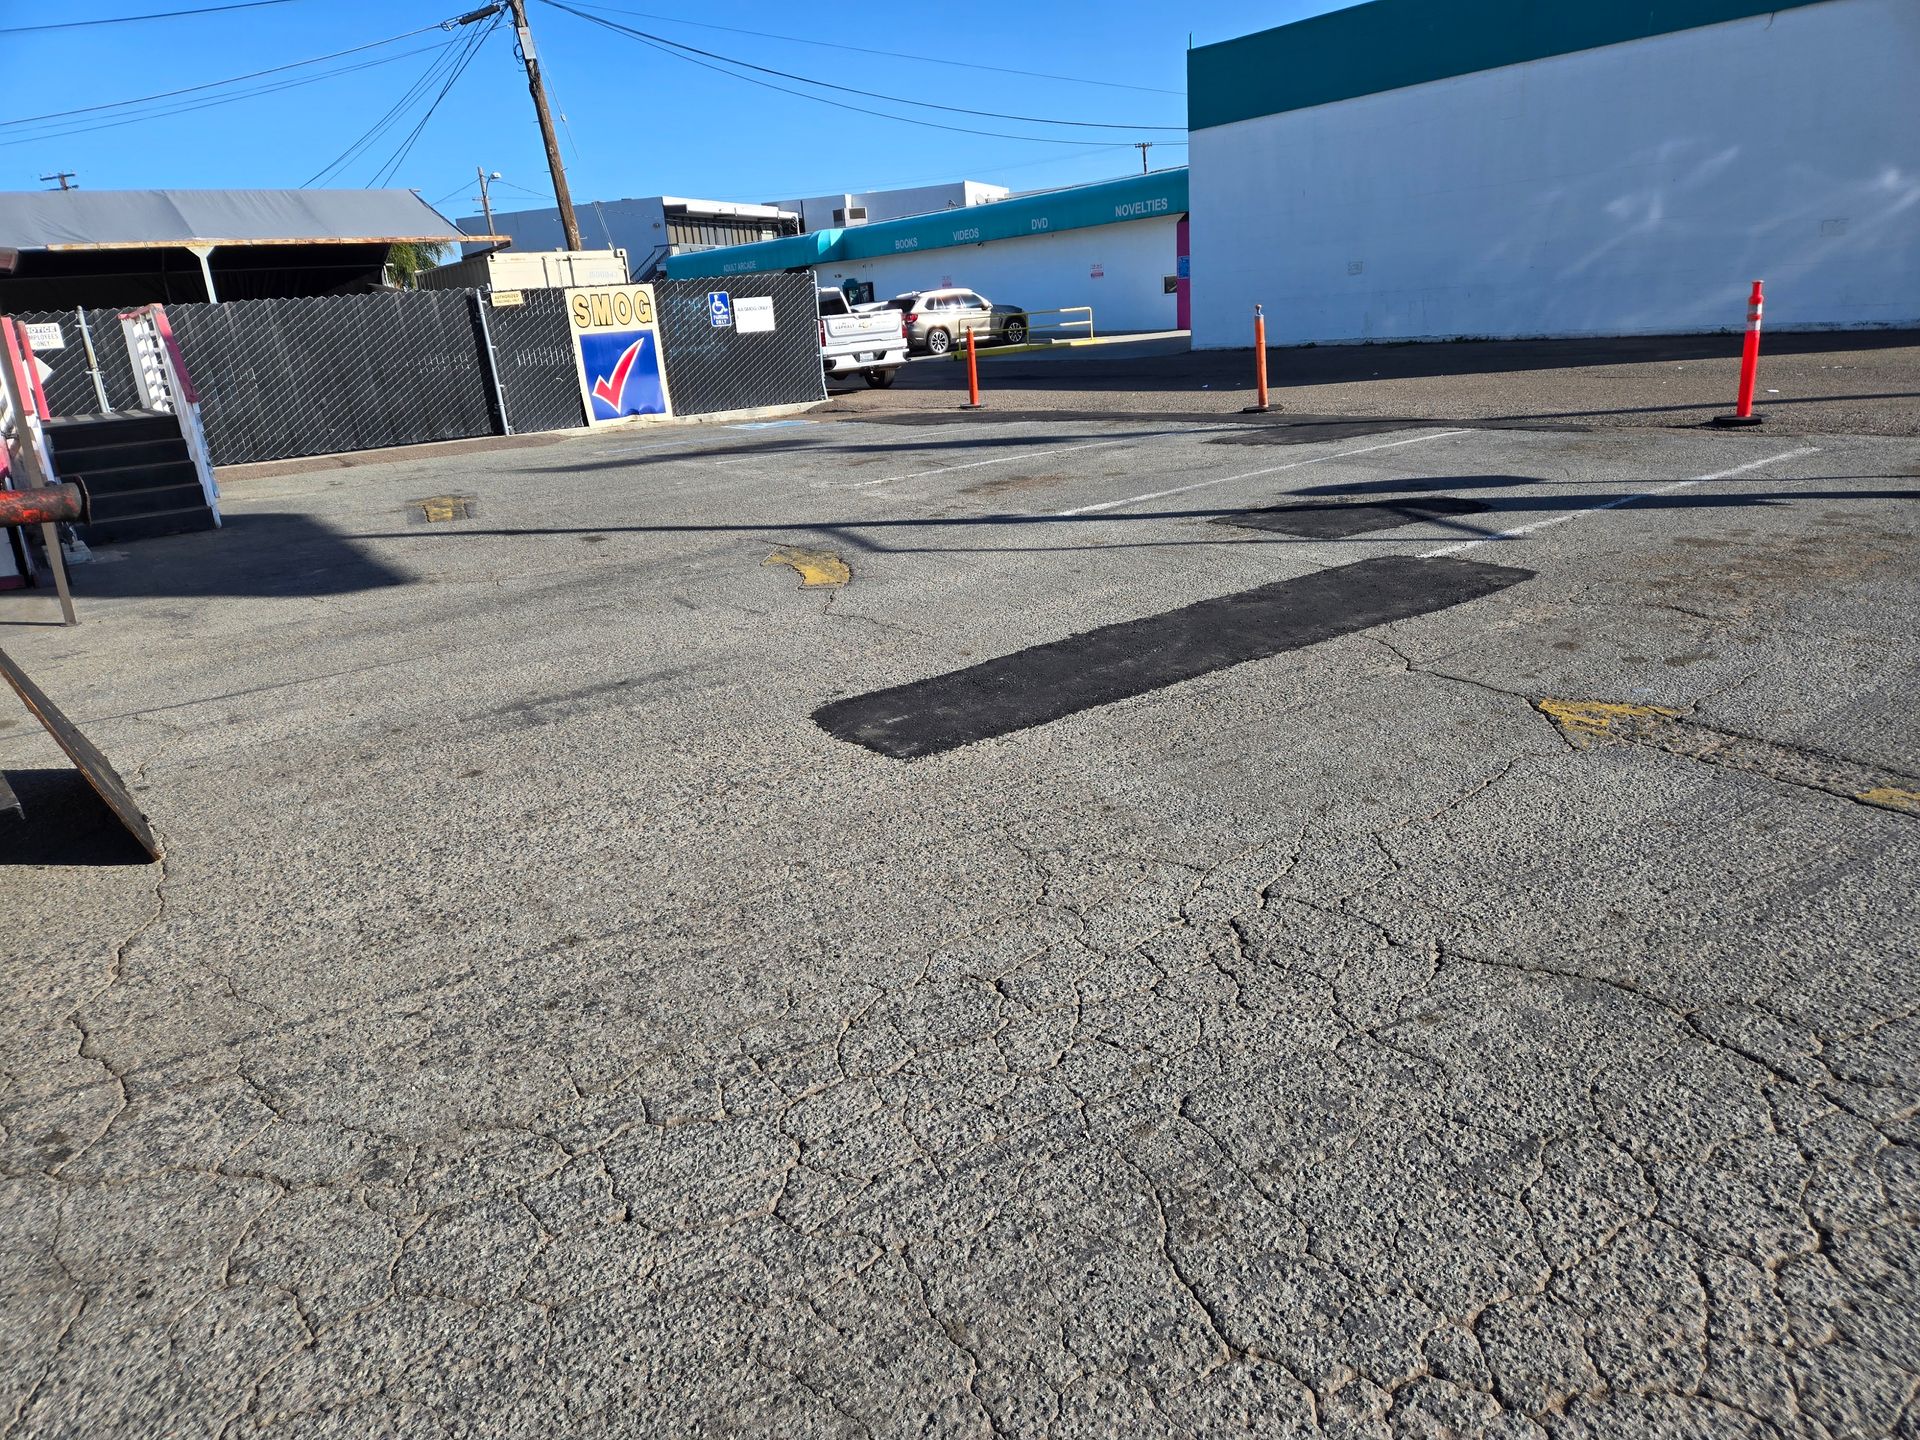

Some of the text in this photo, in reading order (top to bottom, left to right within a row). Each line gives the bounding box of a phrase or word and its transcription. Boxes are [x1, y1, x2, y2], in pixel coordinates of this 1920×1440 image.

[1115, 198, 1168, 217] NOVELTIES
[1031, 217, 1049, 230] DVD
[953, 228, 980, 241] VIDEOS
[895, 237, 919, 250] BOOKS
[723, 260, 757, 273] ADULT ARCADE
[572, 290, 653, 328] SMOG
